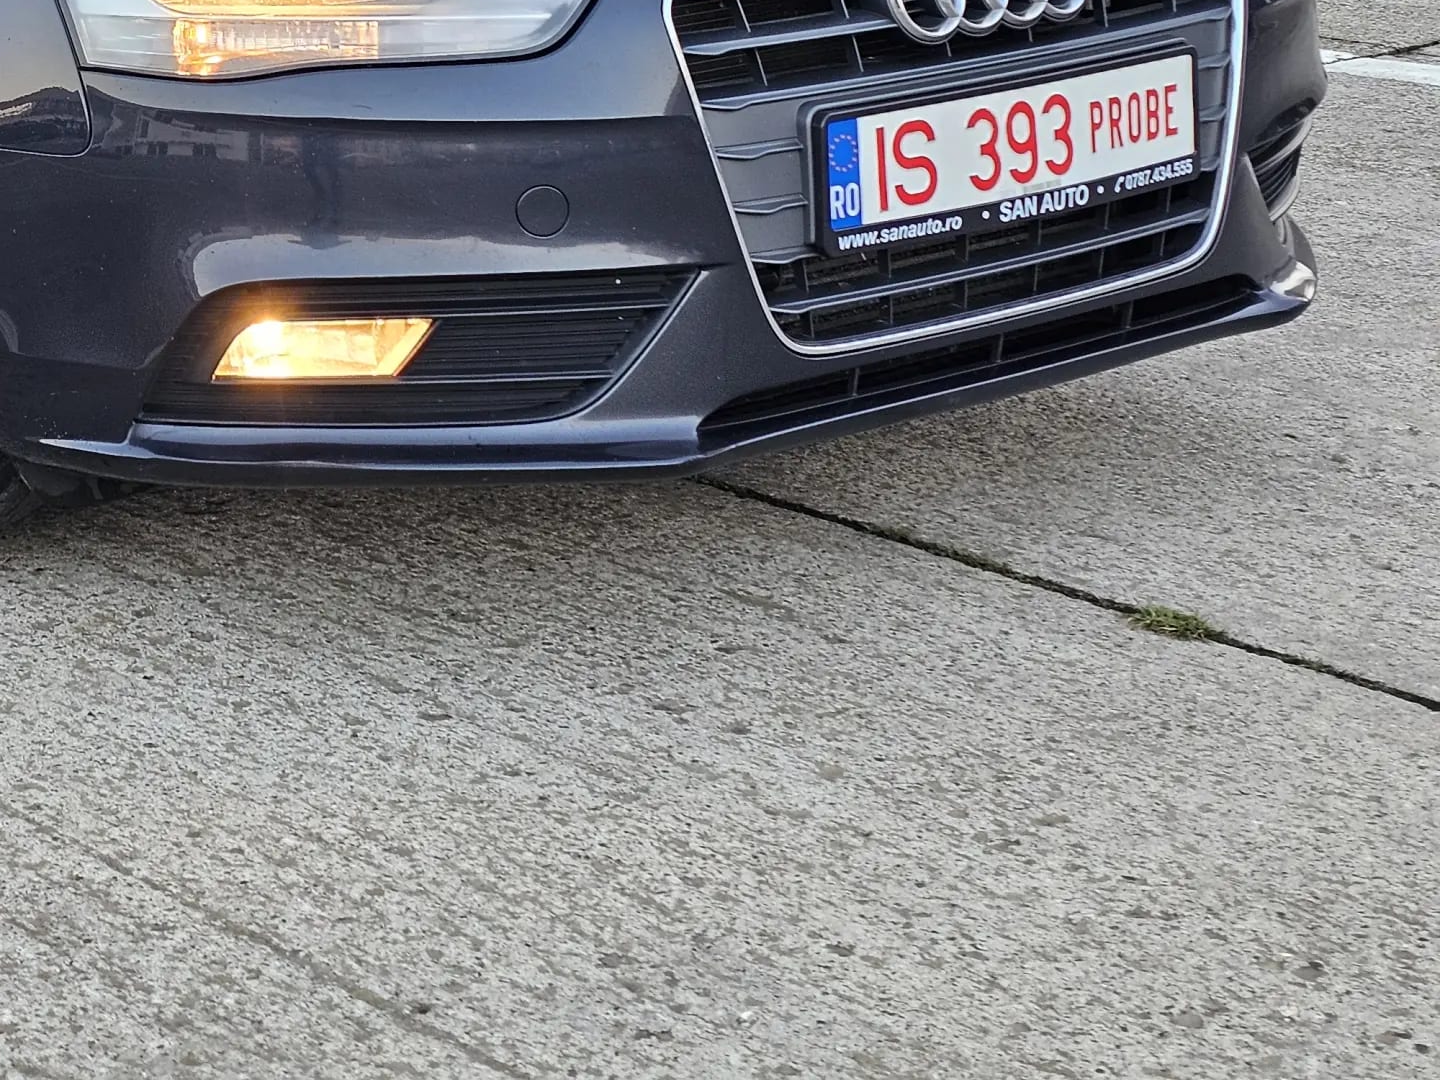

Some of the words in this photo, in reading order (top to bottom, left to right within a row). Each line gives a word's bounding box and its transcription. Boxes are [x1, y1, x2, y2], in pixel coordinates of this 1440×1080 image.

[875, 119, 939, 212] IS
[965, 93, 1074, 192] 393
[1089, 84, 1179, 154] PROBE
[829, 182, 861, 220] RO
[837, 215, 963, 251] www.sanauto.ro
[999, 195, 1038, 222] SAN
[1039, 184, 1090, 214] AUTO
